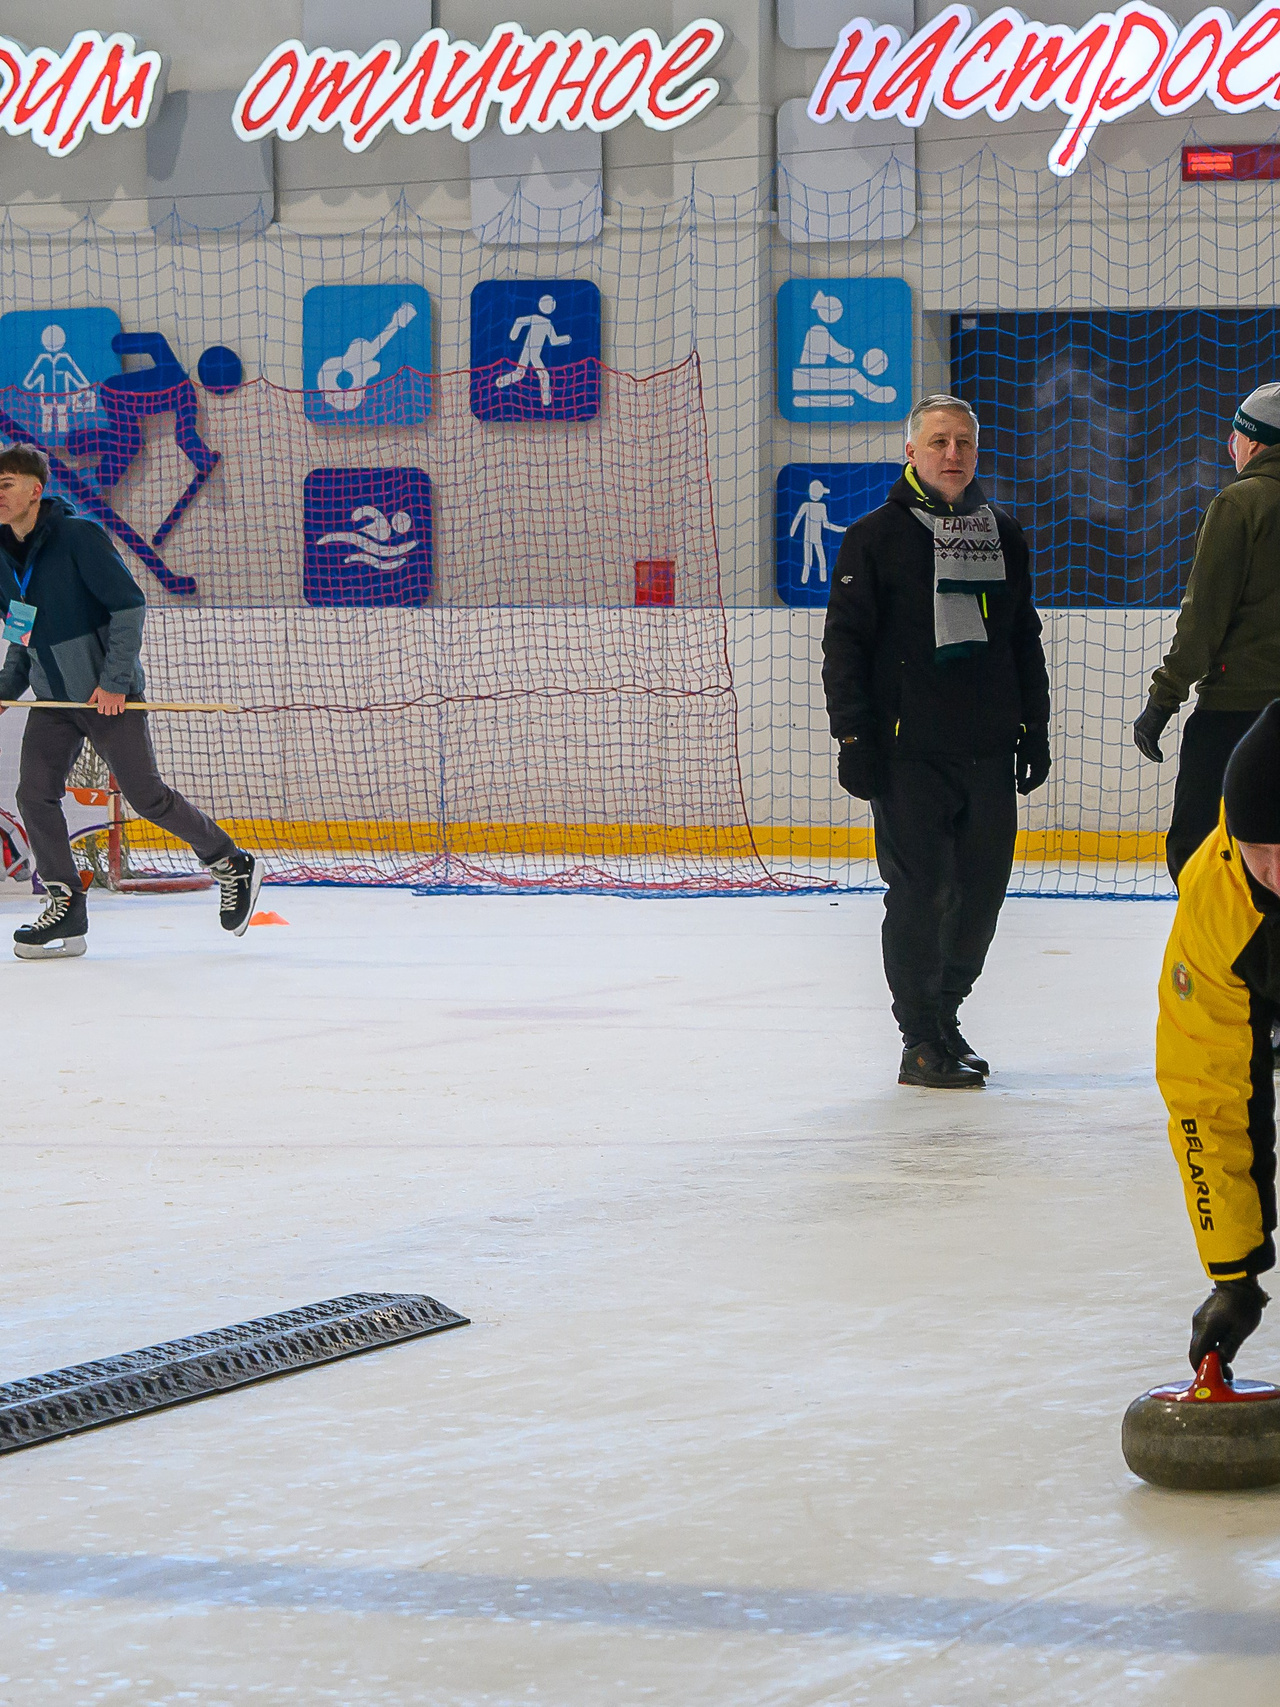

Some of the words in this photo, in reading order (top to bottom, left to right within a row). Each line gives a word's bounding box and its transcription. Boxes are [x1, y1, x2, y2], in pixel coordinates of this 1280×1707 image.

[0, 40, 153, 150] им
[238, 27, 717, 145] отличное
[942, 516, 992, 533] ЕДИНЫЕ
[90, 791, 99, 804] 7
[1181, 1118, 1215, 1231] BELARUS
